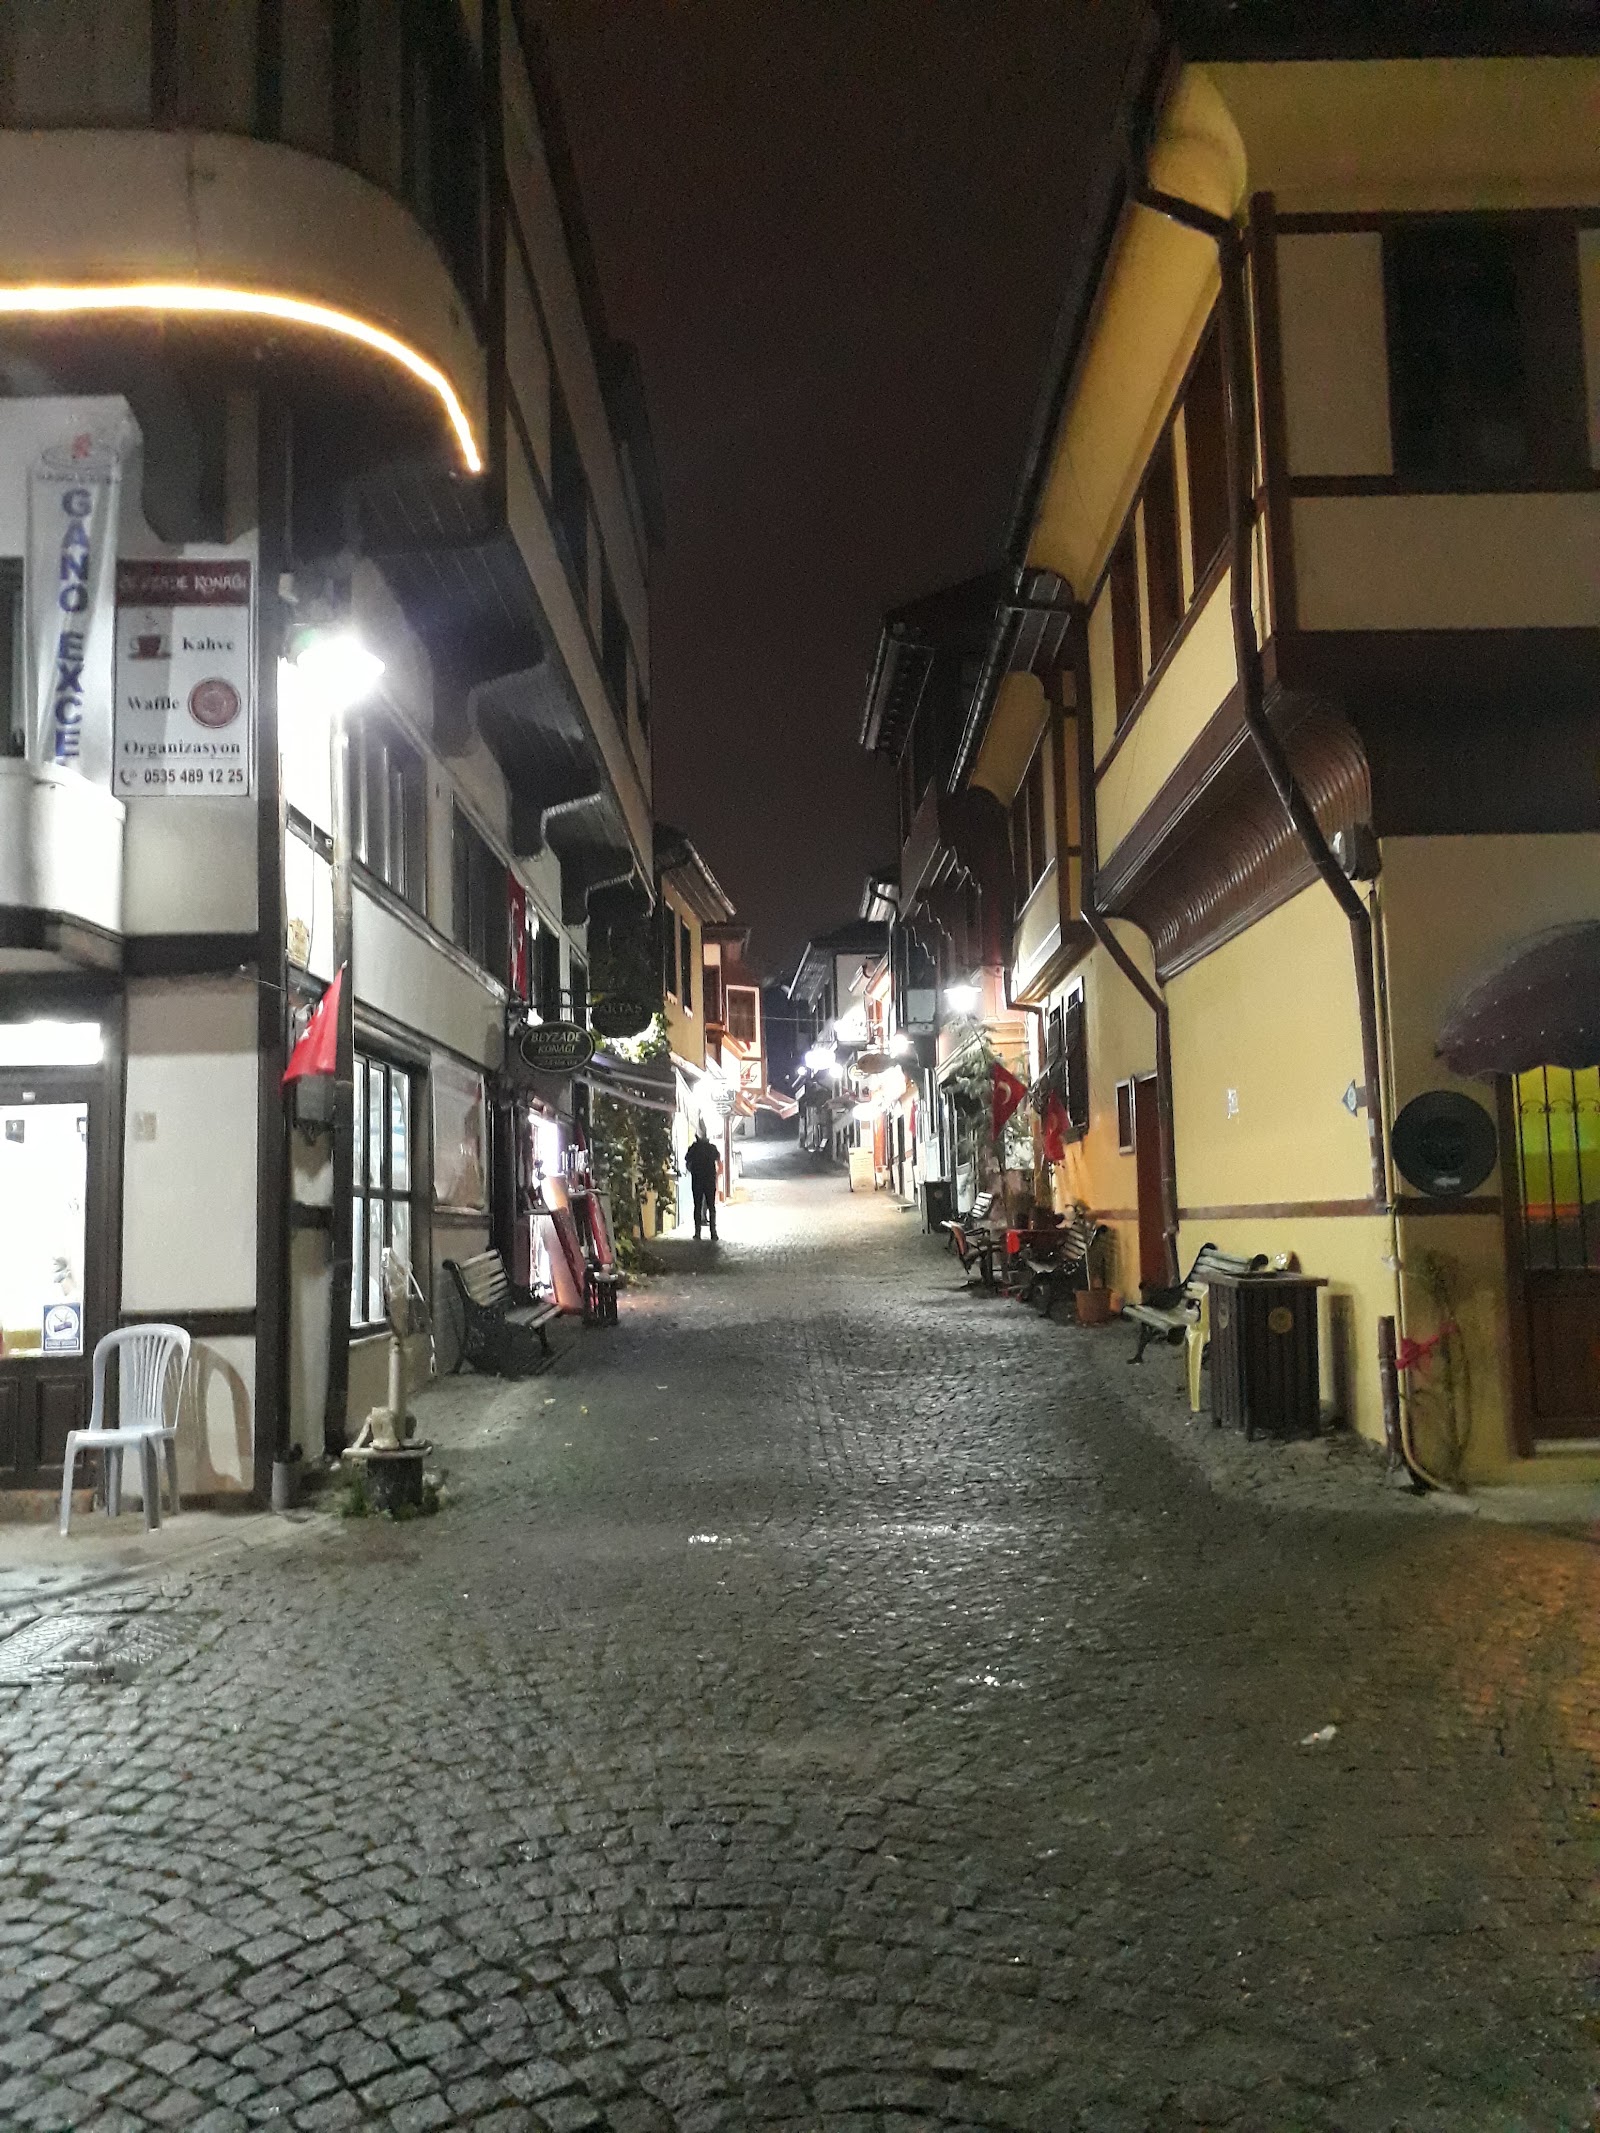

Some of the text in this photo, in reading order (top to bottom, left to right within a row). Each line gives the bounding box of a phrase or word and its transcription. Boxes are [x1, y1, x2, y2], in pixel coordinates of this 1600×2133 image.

[55, 488, 92, 766] GANO EXCE
[182, 636, 235, 651] Kahve
[127, 696, 180, 710] Waffle
[123, 738, 241, 757] Organizasyon
[143, 768, 243, 784] 0535 489 12 25
